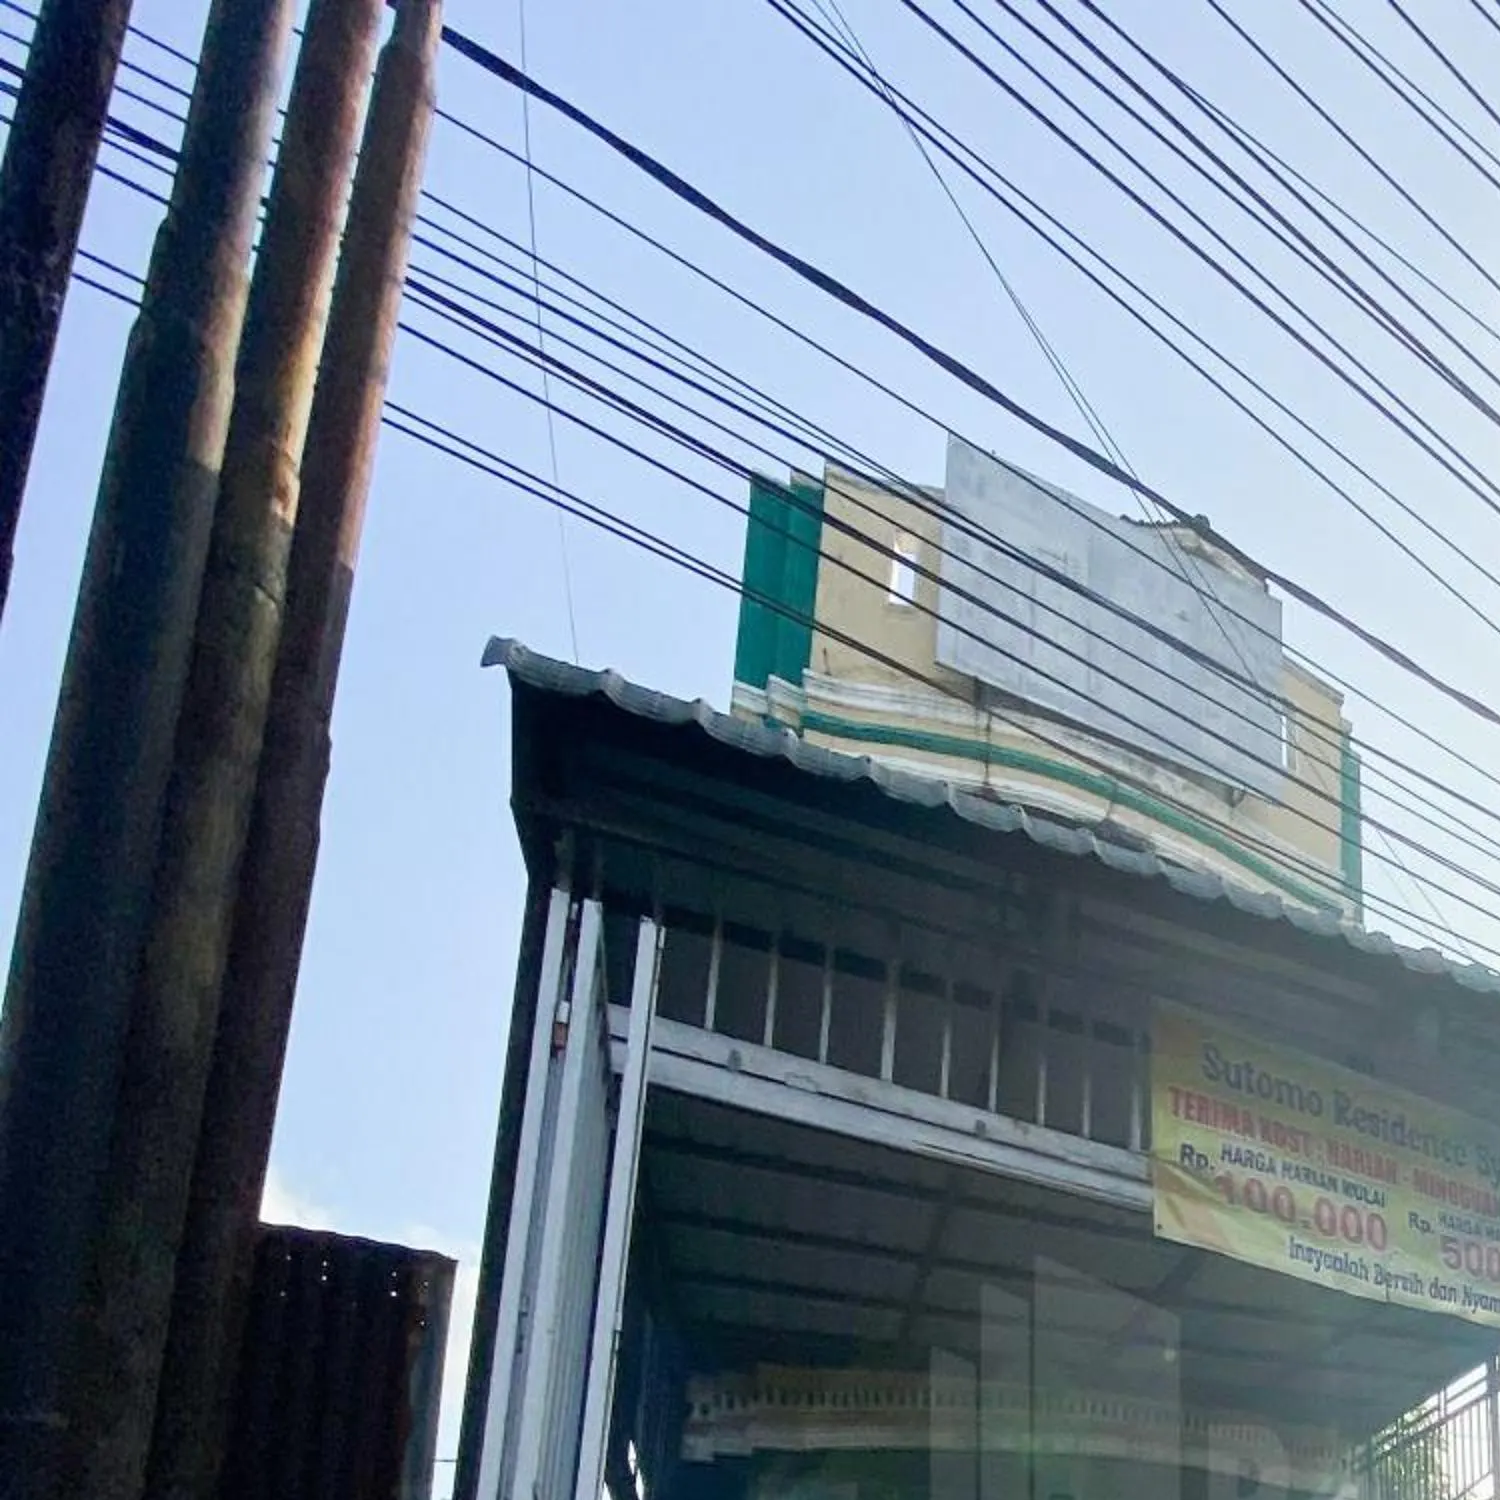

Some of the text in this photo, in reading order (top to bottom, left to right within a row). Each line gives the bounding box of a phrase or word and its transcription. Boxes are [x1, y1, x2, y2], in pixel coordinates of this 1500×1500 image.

[1168, 1086, 1253, 1136] TERIMA
[1259, 1114, 1311, 1157] KOST
[1202, 1042, 1322, 1117] Sutomo
[1333, 1090, 1467, 1166] Residence
[1180, 1143, 1387, 1208] Rp. HARGA HARIAN MULAI
[1408, 1211, 1434, 1235] Rp.
[1429, 1275, 1457, 1303] dan
